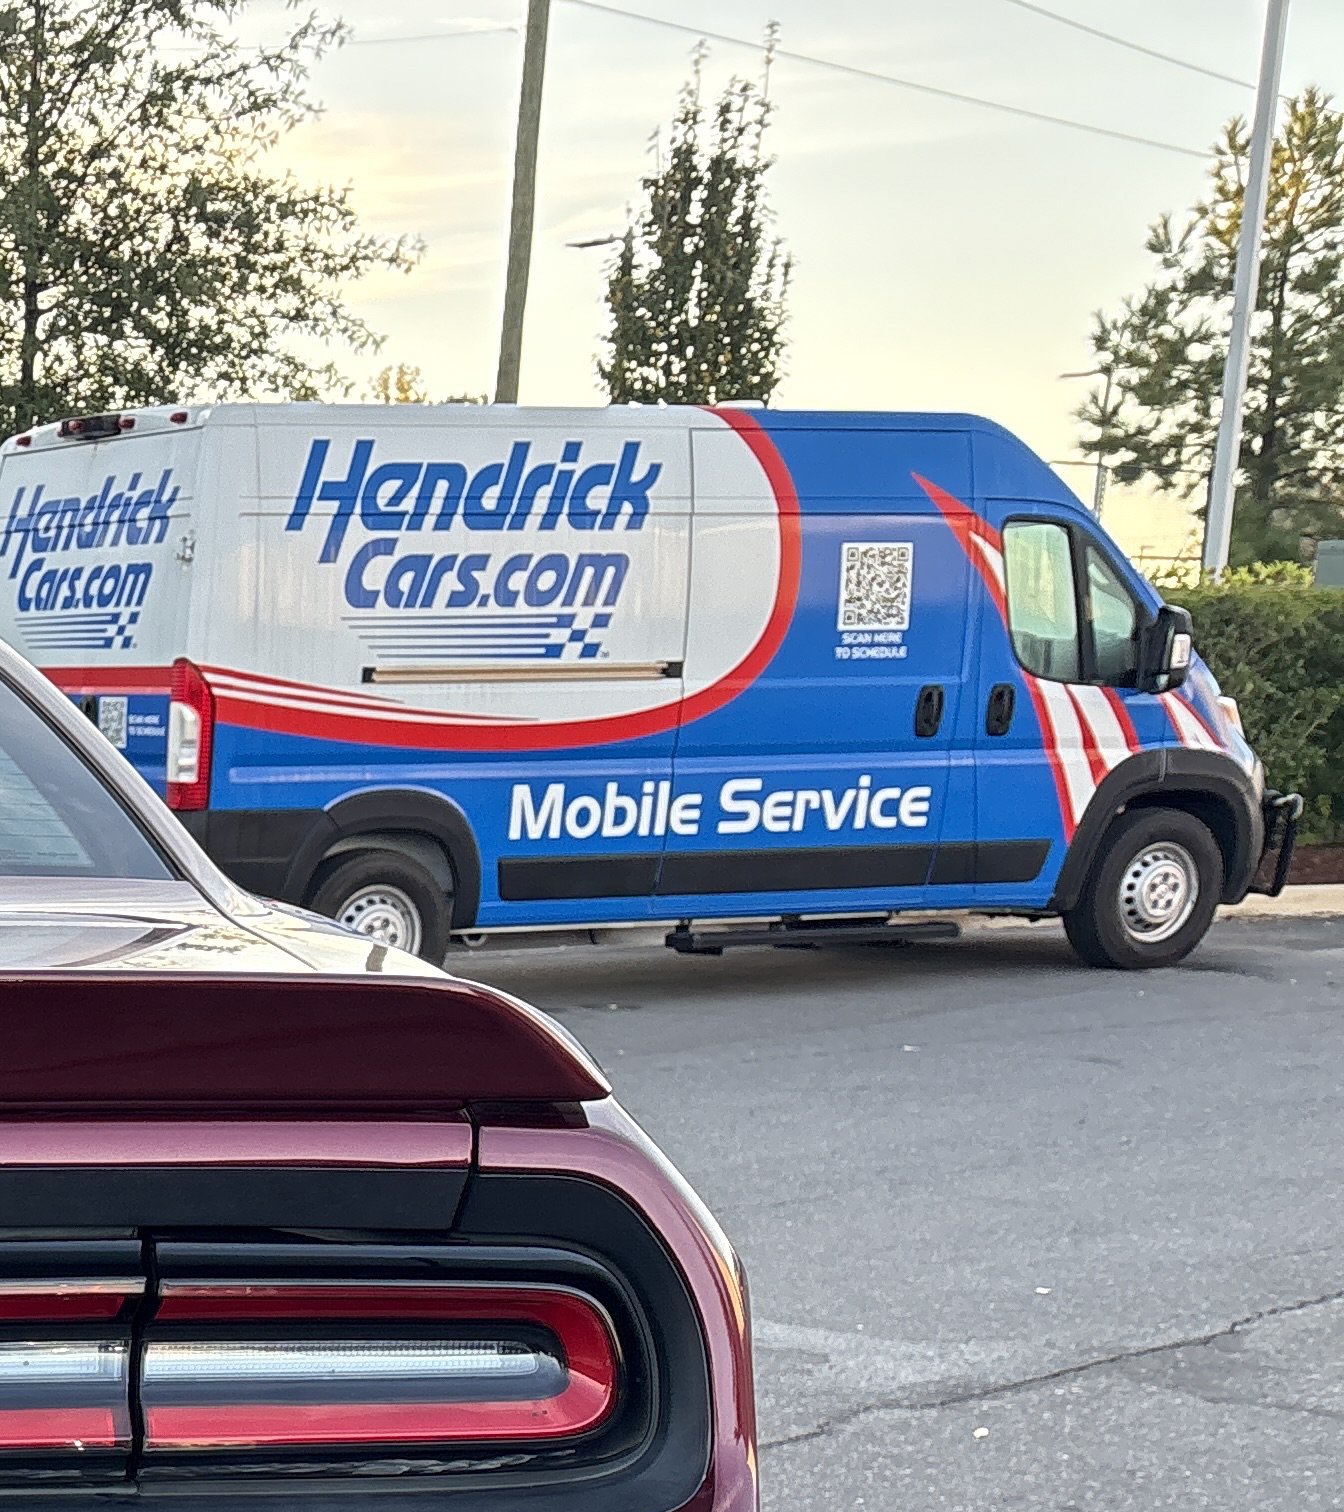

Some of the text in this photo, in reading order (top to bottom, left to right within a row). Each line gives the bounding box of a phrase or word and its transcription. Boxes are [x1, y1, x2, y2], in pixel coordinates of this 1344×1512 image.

[285, 438, 663, 563] Hendrick
[17, 557, 153, 612] Cars.com
[344, 537, 630, 609] Cars.com
[835, 645, 908, 659] TO SCHEDULE
[841, 631, 903, 645] SCAN HERE
[508, 774, 932, 841] Mobile Service
